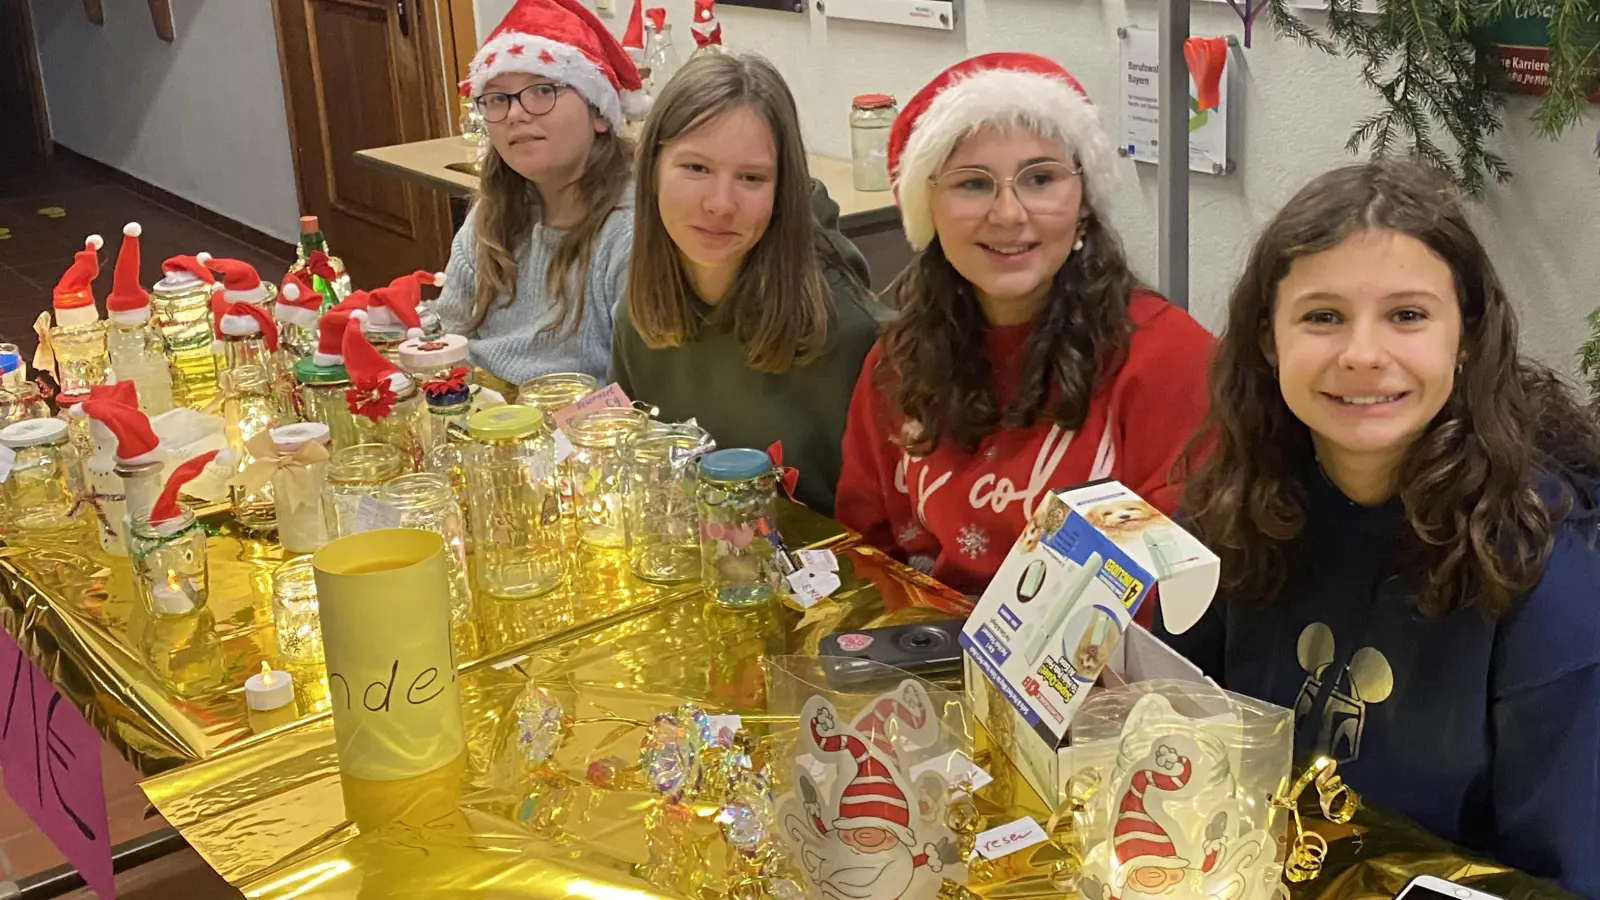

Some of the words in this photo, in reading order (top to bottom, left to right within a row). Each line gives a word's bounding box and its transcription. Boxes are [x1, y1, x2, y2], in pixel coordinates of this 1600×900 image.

[1512, 56, 1550, 72] Karriere
[1128, 74, 1149, 86] Bayern
[1051, 677, 1074, 703] Super
